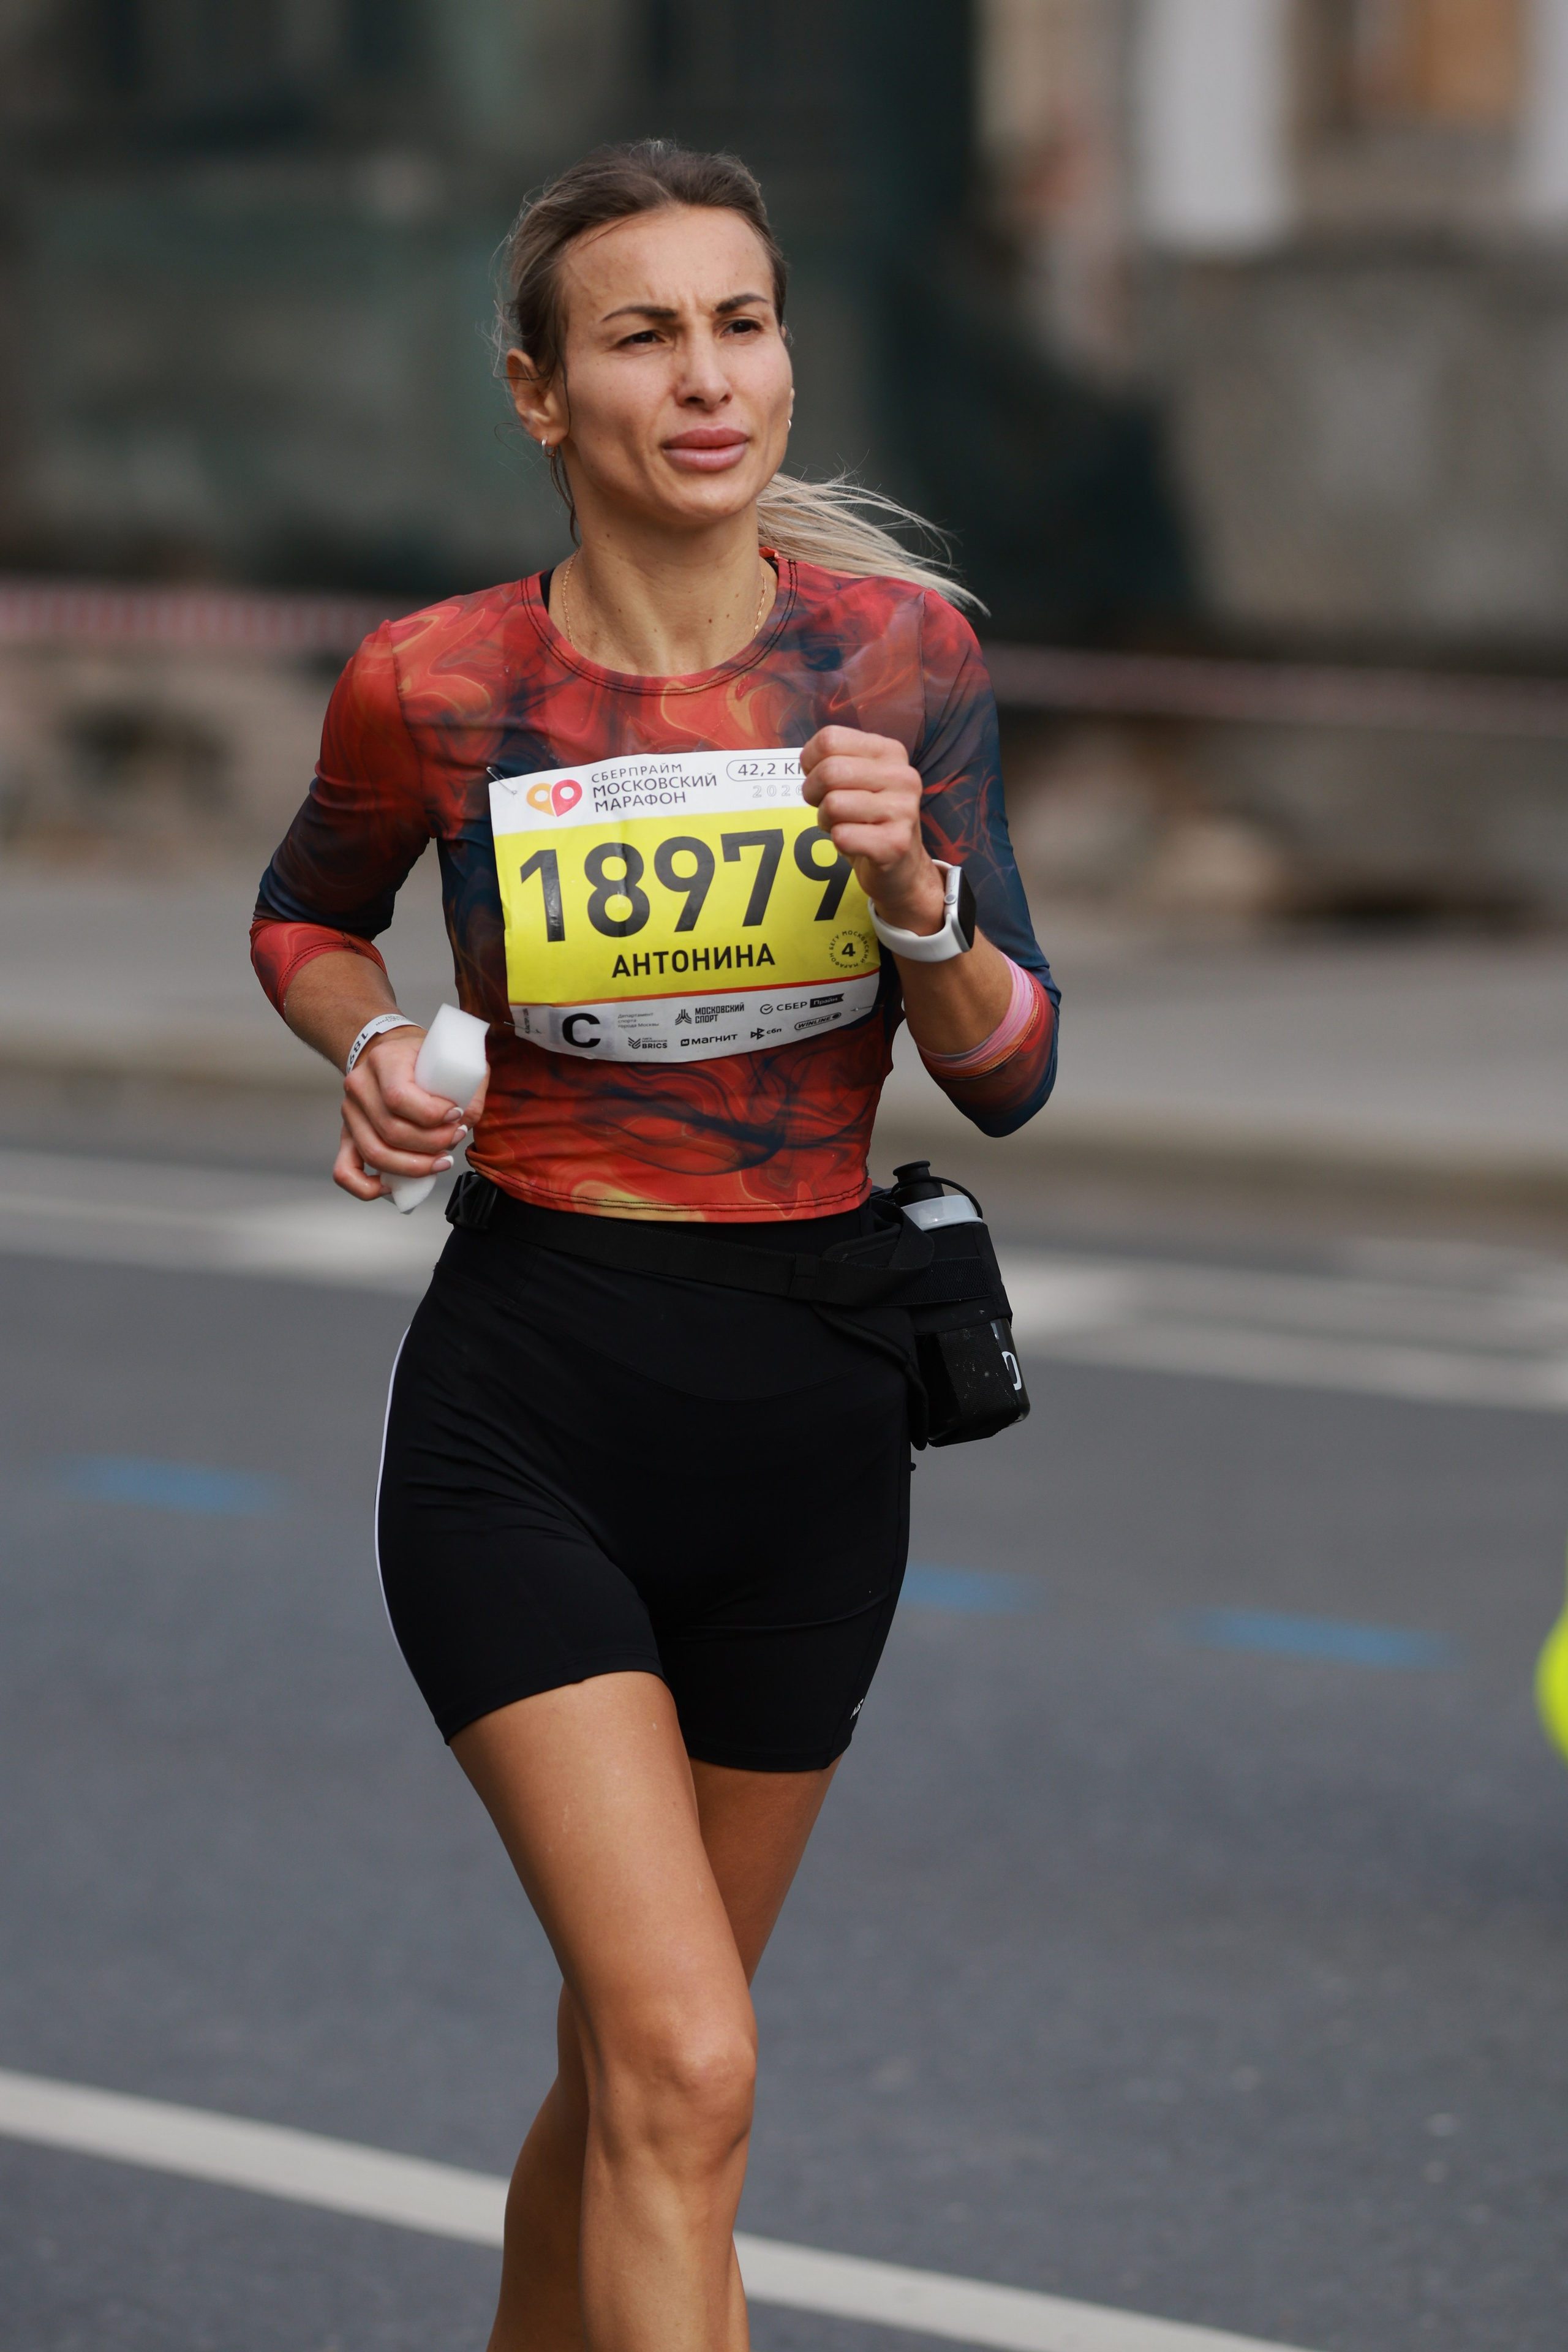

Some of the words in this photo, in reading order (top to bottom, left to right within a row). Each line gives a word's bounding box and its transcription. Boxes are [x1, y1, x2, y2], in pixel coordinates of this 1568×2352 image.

[592, 763, 682, 783] СБЕРПРАЙМ
[737, 763, 776, 777] 42,2
[593, 772, 717, 798] МОСКОВСКИЙ
[595, 791, 686, 813] МАРАФОН
[519, 825, 854, 943] 18979
[842, 942, 856, 957] 4
[612, 943, 776, 978] АНТОНИНА
[695, 1002, 745, 1016] МОСКОВСКИЙ
[776, 1001, 807, 1011] СБЕР
[695, 1014, 718, 1024] СПОРТ
[797, 1016, 831, 1029] WINLINE
[347, 1033, 368, 1074] 189
